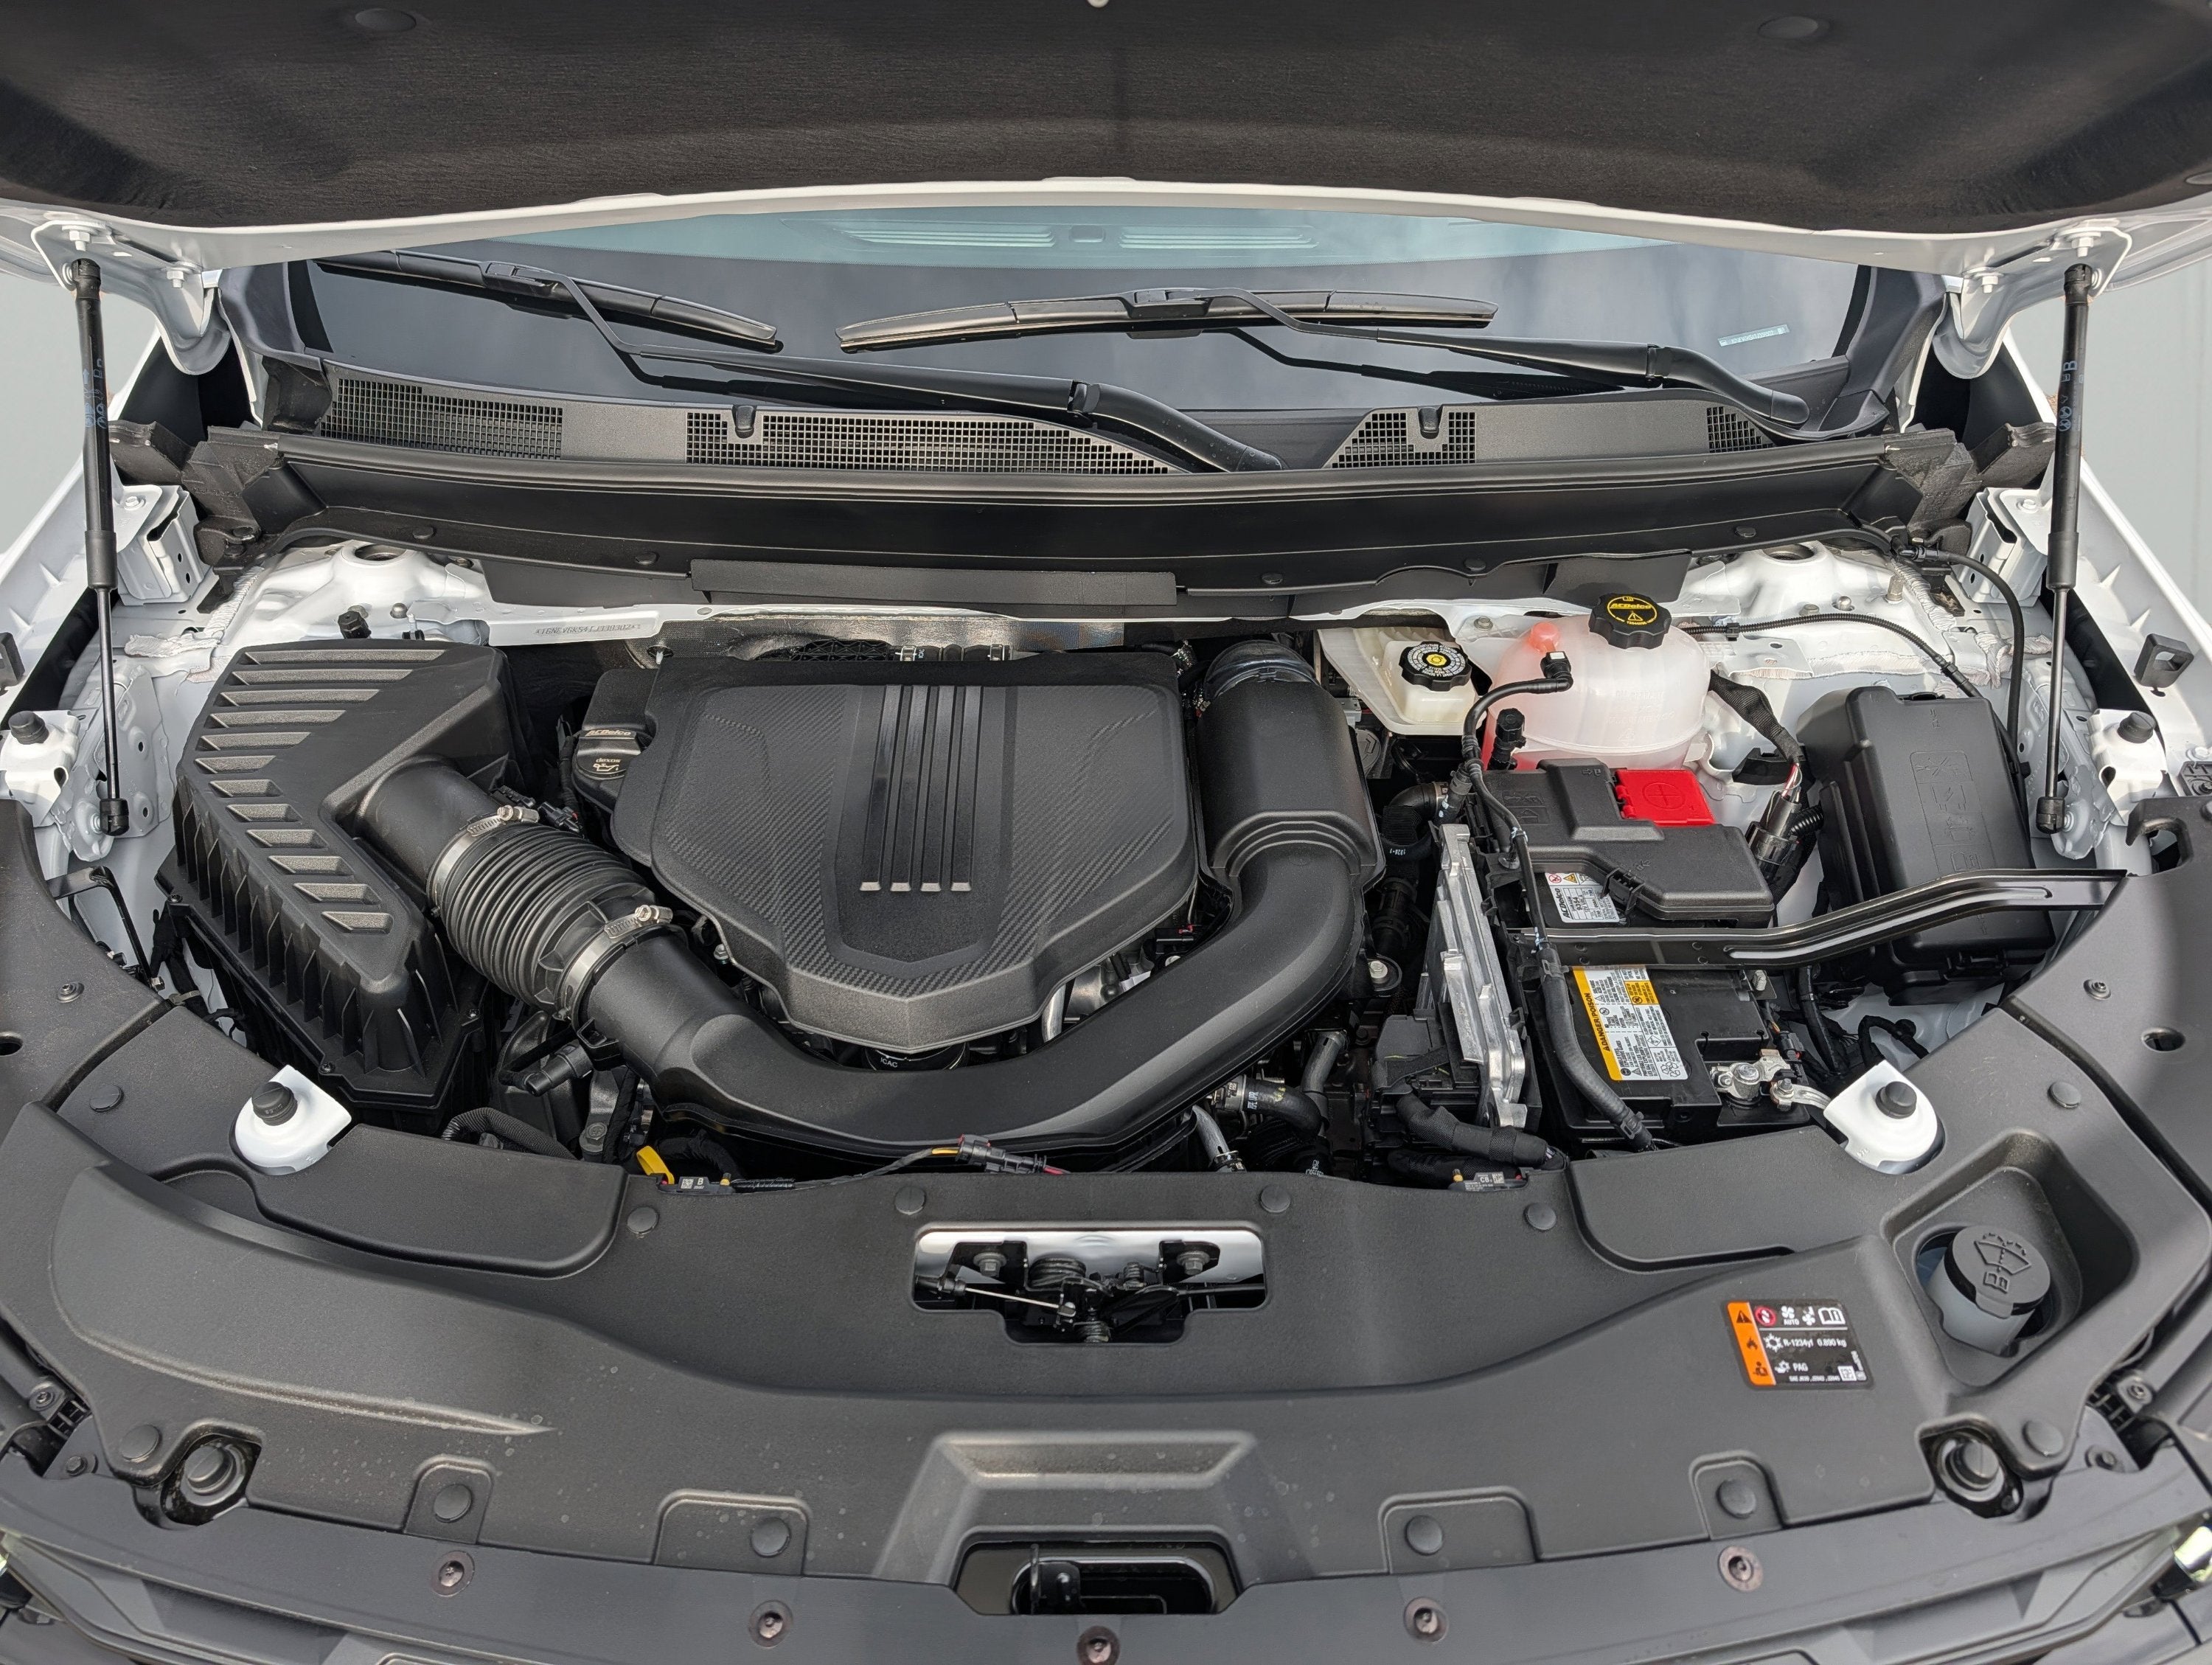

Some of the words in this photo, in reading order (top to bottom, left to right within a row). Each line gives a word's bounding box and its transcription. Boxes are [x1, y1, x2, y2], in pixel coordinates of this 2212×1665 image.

[1555, 888, 1570, 918] ACDelco
[1573, 897, 1582, 910] 9354
[1584, 992, 1608, 1047] DANGER/POISON
[697, 1178, 704, 1186] B
[1784, 1318, 1800, 1326] AUTO
[1783, 1338, 1814, 1349] R-1234yf
[1836, 1338, 1848, 1348] kg
[1792, 1362, 1809, 1372] PAG
